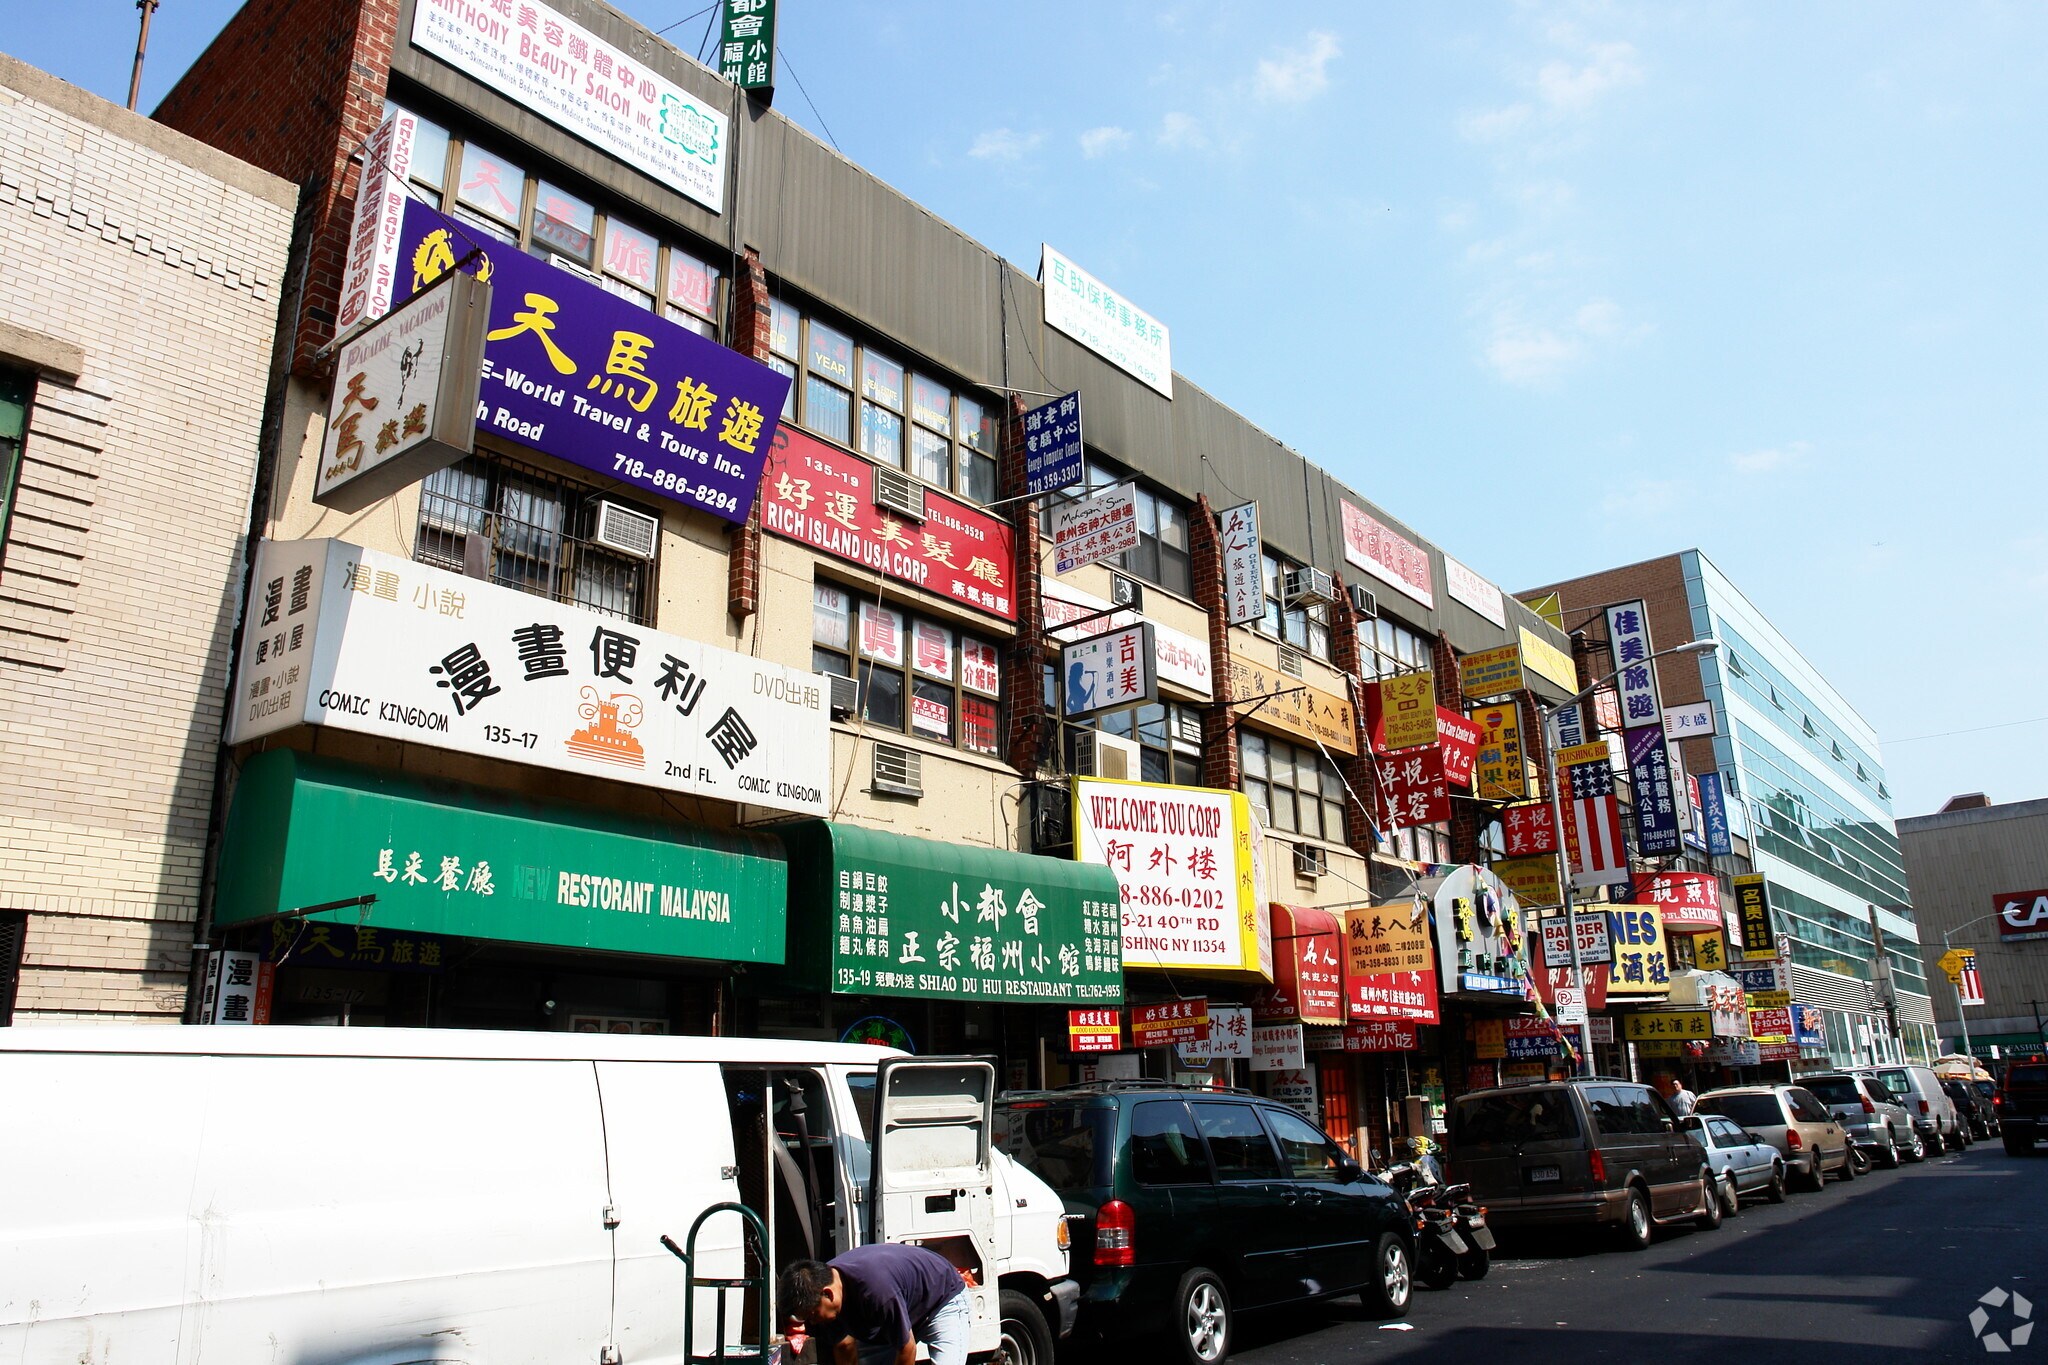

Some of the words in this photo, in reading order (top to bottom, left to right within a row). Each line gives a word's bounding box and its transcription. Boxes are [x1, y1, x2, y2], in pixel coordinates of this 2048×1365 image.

[519, 32, 577, 85] BEAUTY
[585, 72, 630, 118] SALON
[636, 111, 654, 132] INC.
[394, 118, 415, 183] ANTHONY
[383, 193, 402, 255] BEAUTY
[371, 263, 391, 319] SALON
[486, 292, 764, 454] 天馬旅遊
[815, 351, 846, 377] YEAR
[493, 406, 545, 442] Road
[1027, 396, 1076, 432] 謝老師
[573, 395, 632, 435] Travel
[637, 424, 651, 443] &
[660, 432, 708, 466] Tours
[714, 452, 746, 480] Inc.
[1027, 420, 1078, 453] 電腦中心
[804, 456, 859, 488] 135-19
[1028, 454, 1042, 473] George
[1043, 446, 1064, 469] Computer
[1065, 440, 1080, 459] Center
[612, 452, 738, 514] 718-886-8294
[1028, 478, 1042, 495] 718
[1043, 462, 1081, 490] 359-3307
[1105, 497, 1126, 510] Sun
[767, 501, 804, 538] RICH
[808, 516, 860, 559] ISLAND
[864, 539, 890, 572] USA
[774, 472, 1004, 588] 好運美髮廳
[927, 508, 985, 542] TEL.886-3528
[1225, 510, 1249, 555] 名人
[1074, 536, 1137, 566] Tel:718-939-2988
[261, 564, 313, 628] 漫畫
[951, 580, 1010, 614] 蒸氣指壓
[255, 623, 304, 666] 便利屋
[1119, 634, 1138, 697] 吉美
[1614, 610, 1655, 720] 佳美旅遊
[249, 690, 292, 723] DVD出租
[429, 622, 758, 770] 漫畫便利屋
[753, 672, 820, 711] DVD出租
[318, 689, 371, 716] COMIC
[379, 701, 449, 733] KINGDOM
[1388, 718, 1433, 734] 718-463-5496
[483, 724, 539, 750] 135-17
[1558, 746, 1595, 763] FLUSHING
[1595, 743, 1608, 757] BID
[664, 760, 691, 780] 2nd
[697, 767, 717, 785] FL.
[737, 774, 771, 795] COMIC
[776, 781, 822, 804] KINGDOM
[1090, 795, 1158, 834] WELCOME
[1159, 802, 1185, 836] YOU
[1188, 804, 1221, 838] CORP
[1560, 776, 1581, 861] WELCOME
[557, 870, 654, 914] RESTORANT
[660, 884, 731, 924] MALAYSIA
[940, 881, 1047, 937] 小都會
[1197, 918, 1220, 931] RD
[899, 930, 1081, 979] 正宗福州小館
[1172, 938, 1190, 951] NY
[1193, 939, 1226, 954] 11354
[1303, 937, 1338, 967] 名人
[1352, 944, 1373, 956] 135-23
[1355, 956, 1400, 970] 718-358-8833
[222, 958, 253, 1022] 漫畫
[838, 968, 871, 987] 135-19
[919, 974, 957, 992] SHIAO
[962, 977, 978, 993] DU
[982, 979, 1002, 995] HUI
[1004, 980, 1072, 998] RESTAURANT
[1075, 985, 1121, 998] TEL:762-1955
[1140, 1022, 1158, 1031] GOOD
[1159, 1020, 1176, 1029] LUCK
[1177, 1019, 1199, 1028] UNISEX
[1145, 1003, 1193, 1021] 好運美髮
[1630, 1016, 1705, 1036] 臺北酒莊
[1346, 1032, 1414, 1050] 福州小吃
[1511, 1047, 1558, 1057] 718-961-1803
